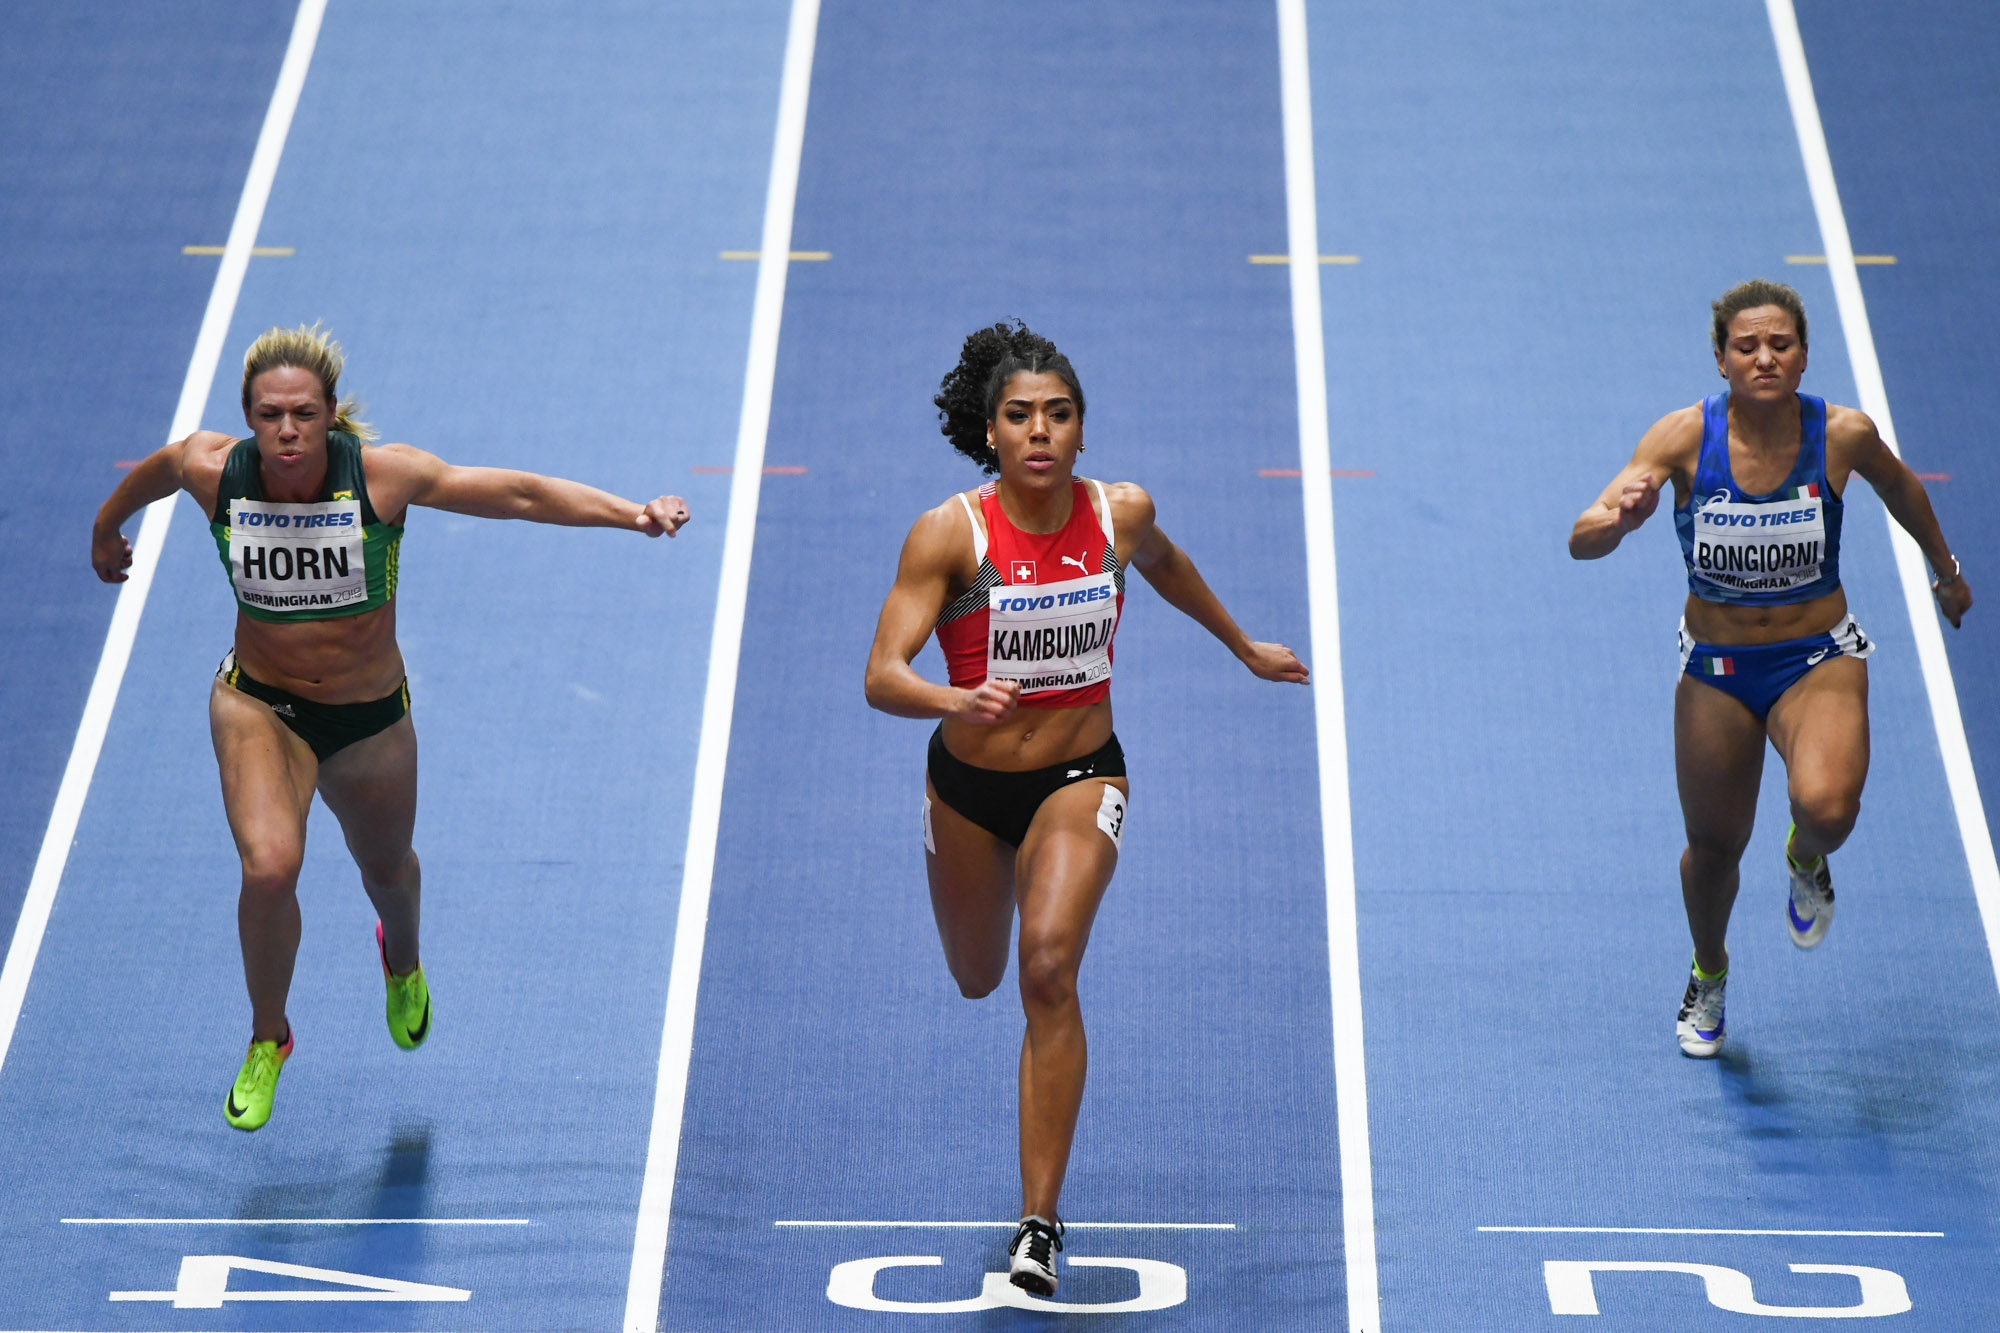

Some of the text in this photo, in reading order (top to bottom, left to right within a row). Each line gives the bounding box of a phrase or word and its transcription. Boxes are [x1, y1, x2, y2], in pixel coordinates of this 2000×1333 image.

[237, 512, 354, 528] TOYO TIRES
[1702, 508, 1816, 527] TOYO TIRES
[242, 546, 349, 581] HORN
[1699, 540, 1818, 573] BONGIORNI
[242, 587, 363, 607] BIRMINGHAM 2018
[999, 585, 1111, 612] TOYO TIRES
[993, 617, 1112, 662] KAMBUNDJI
[995, 662, 1109, 690] MINGHAM 2018
[1110, 804, 1124, 838] 3
[109, 1256, 472, 1308] 4
[827, 1256, 1187, 1313] 3
[1544, 1261, 1912, 1318] 2
